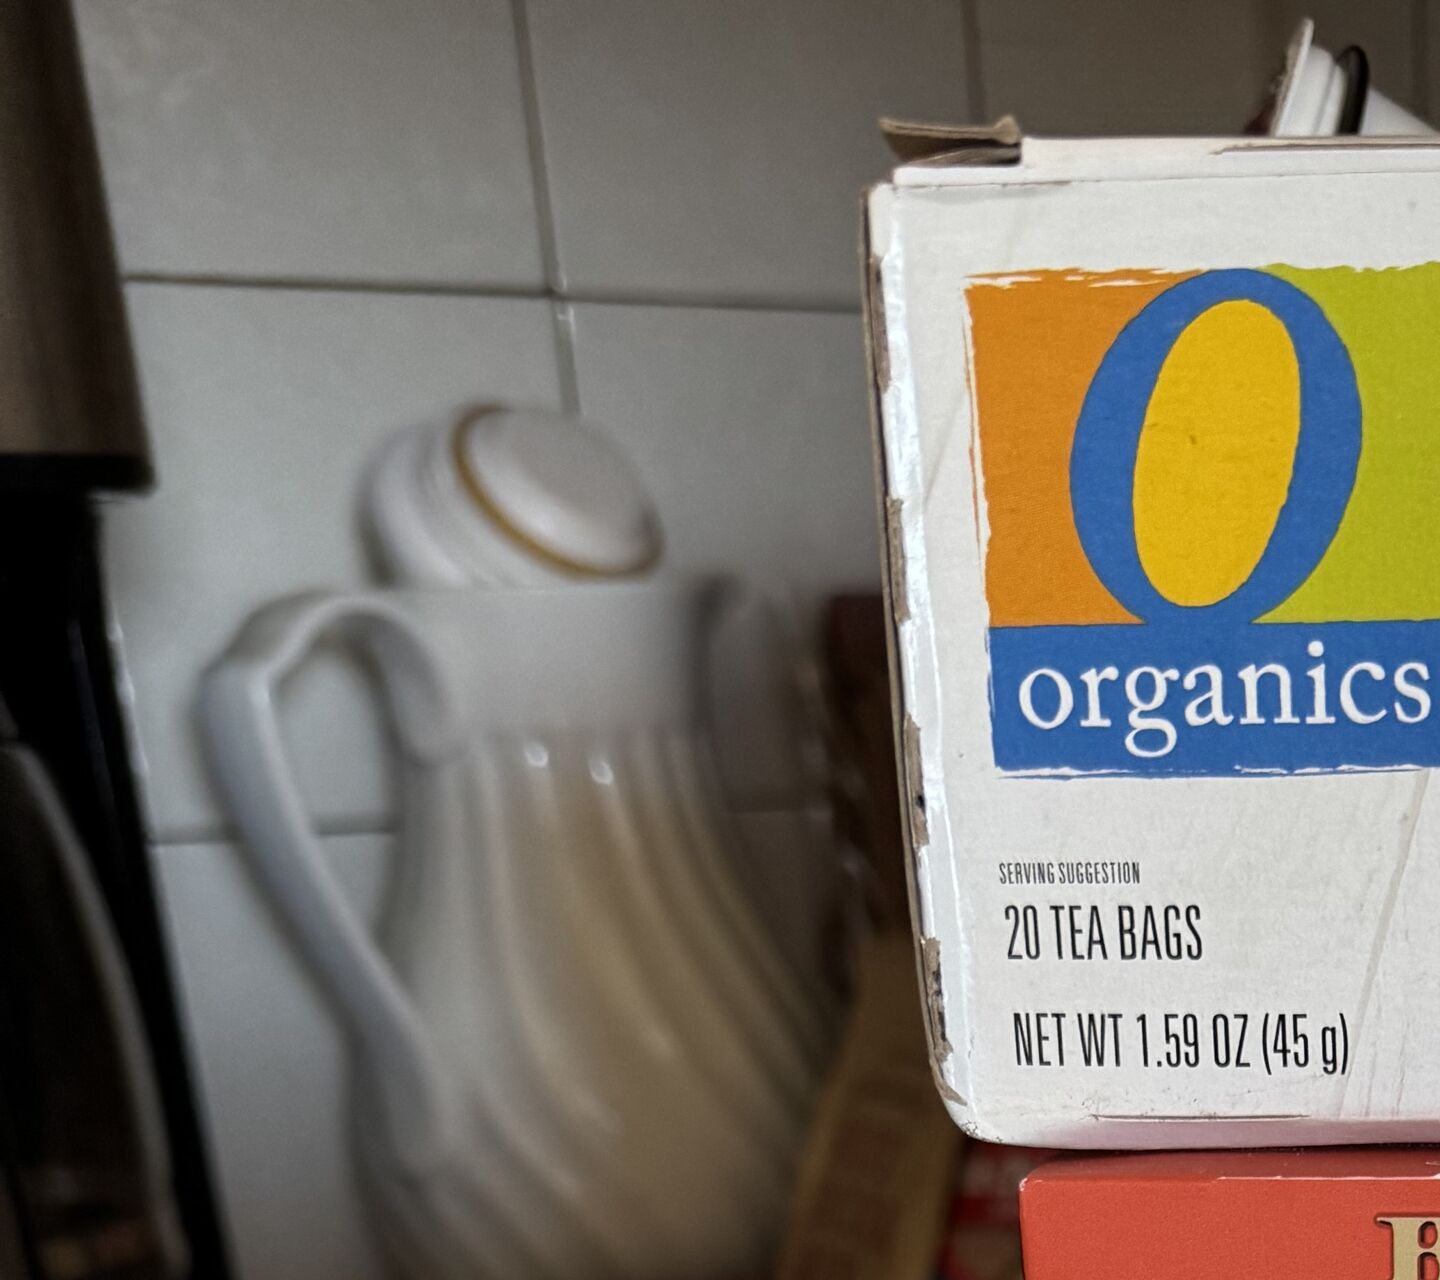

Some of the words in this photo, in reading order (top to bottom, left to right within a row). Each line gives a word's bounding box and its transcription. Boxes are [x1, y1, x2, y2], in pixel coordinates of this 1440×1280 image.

[1018, 640, 1432, 758] organics
[999, 862, 1055, 885] SERVING
[1058, 862, 1141, 885] SUGGESTION
[1004, 904, 1041, 961] 20
[1049, 905, 1108, 960] TEA
[1119, 904, 1203, 961] BAGS
[1013, 1012, 1067, 1068] NET
[1077, 1012, 1123, 1067] WT
[1136, 1013, 1199, 1069] 1.59
[1213, 1013, 1251, 1068] OZ
[1261, 1012, 1310, 1075] (45
[1321, 1012, 1349, 1075] g)
